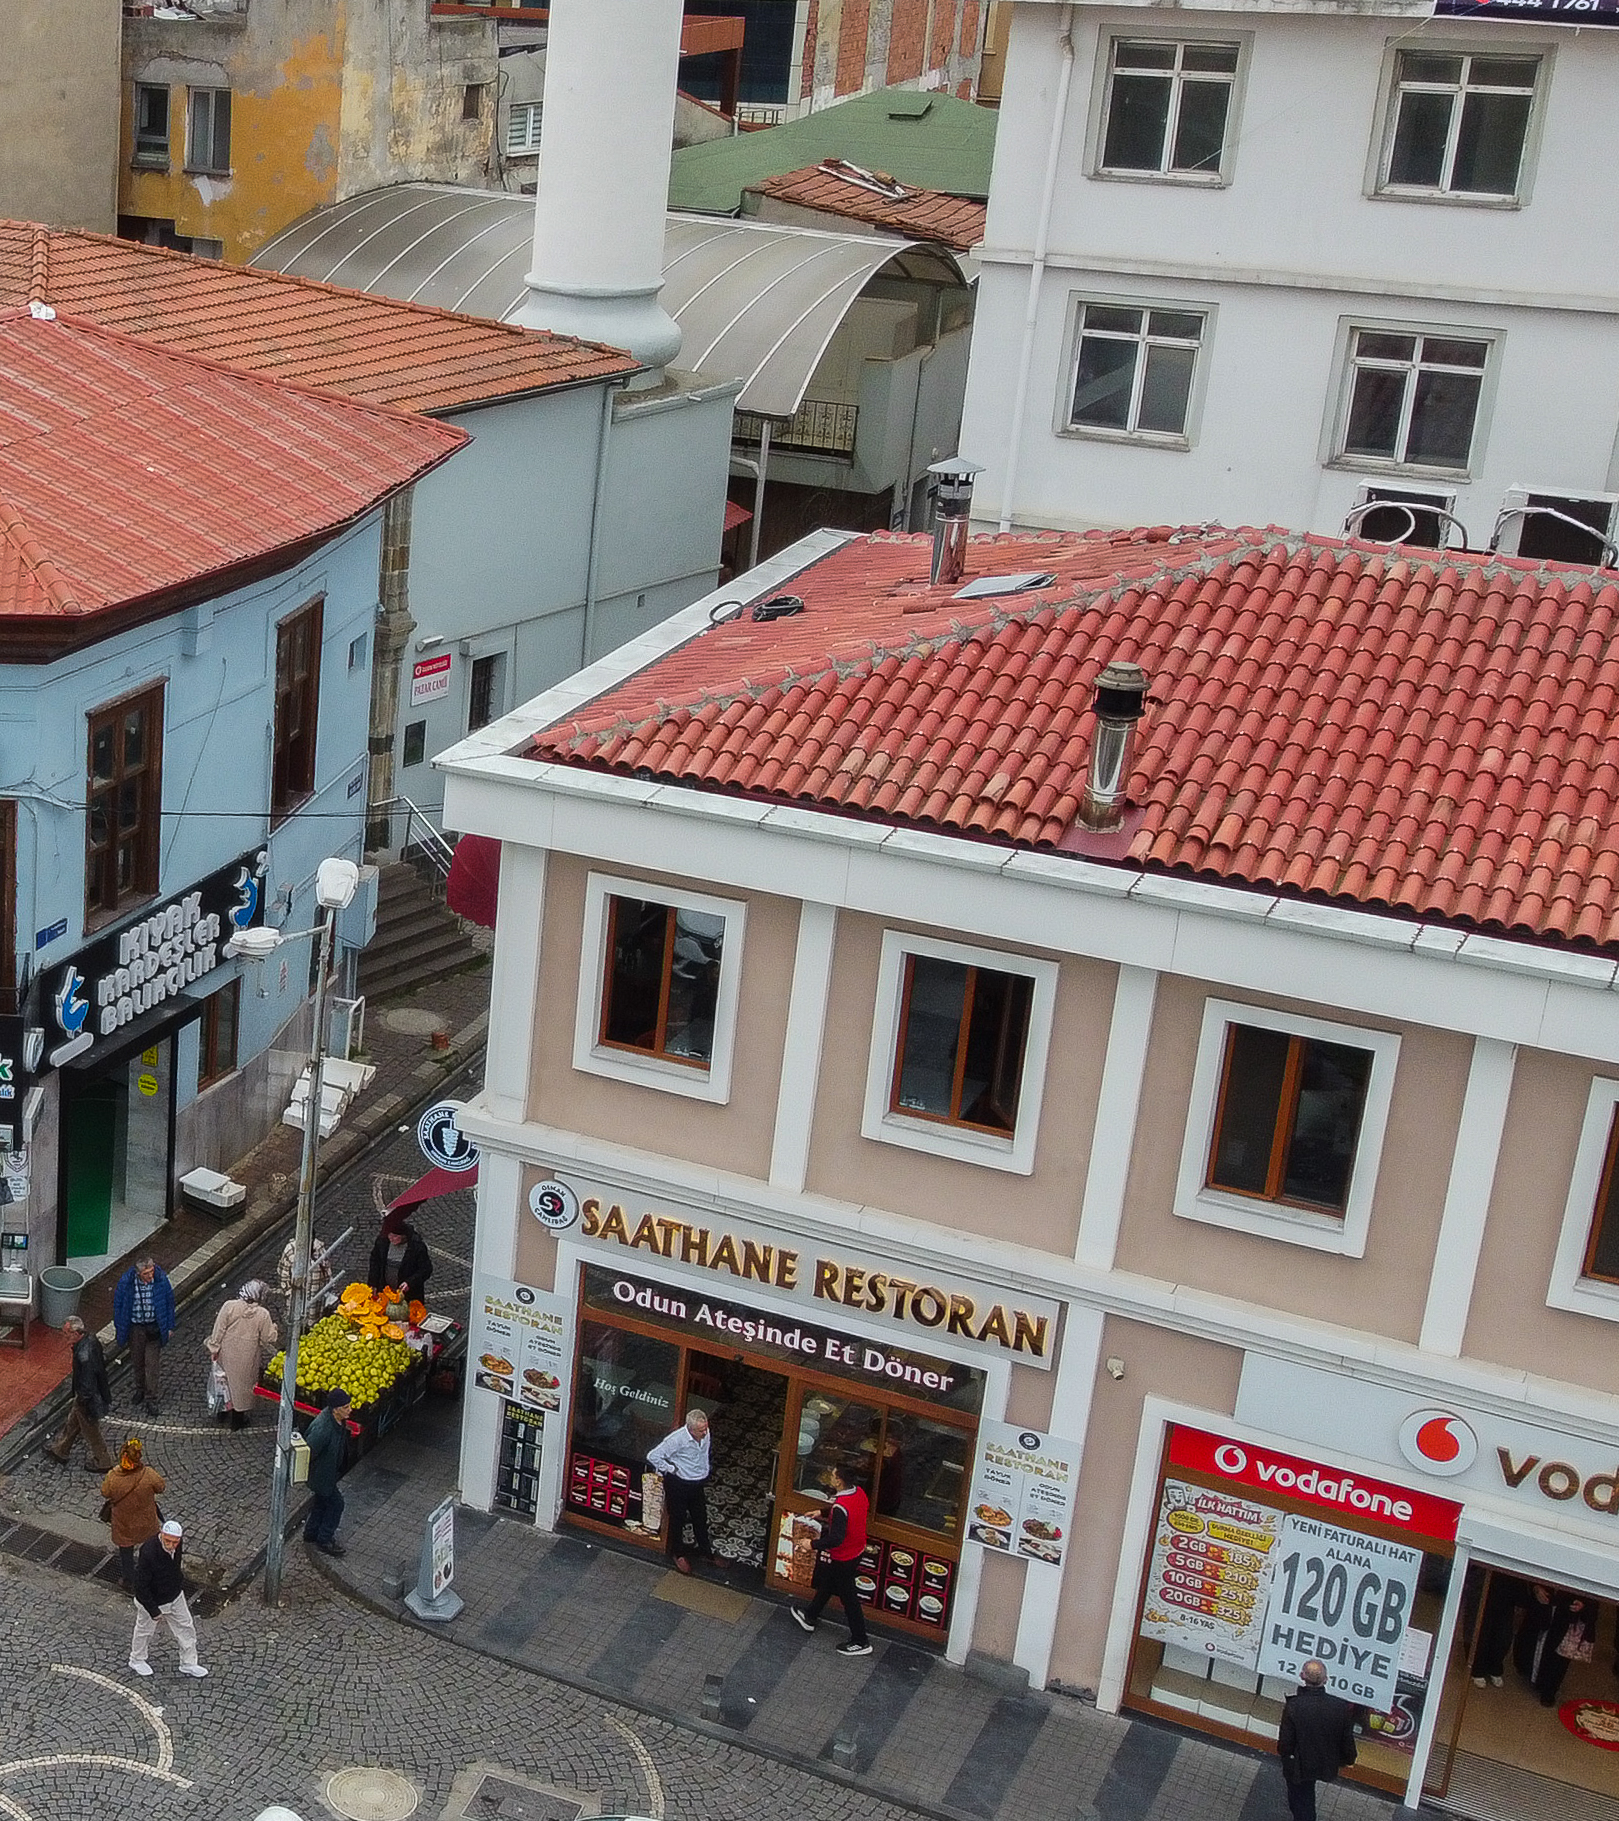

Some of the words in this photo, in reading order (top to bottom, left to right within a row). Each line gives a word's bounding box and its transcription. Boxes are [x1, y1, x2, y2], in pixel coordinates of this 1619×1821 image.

[119, 891, 203, 966] KIYAK
[100, 942, 217, 1036] BALIKÇILIK
[581, 1197, 799, 1291] SAATHANE
[812, 1258, 1050, 1358] RESTORAN
[484, 1295, 563, 1326] SAATHANE
[484, 1304, 563, 1336] RESTORAN
[613, 1281, 688, 1320] Odun
[694, 1303, 817, 1354] Ateşinde
[825, 1337, 856, 1366] Et
[863, 1348, 955, 1393] Döner
[593, 1377, 618, 1396] Hoş
[619, 1385, 670, 1408] Geldiniz
[984, 1452, 1069, 1484] RESTORAN
[985, 1441, 1069, 1473] SAATHANE
[1255, 1460, 1413, 1522] vodafone
[1197, 1496, 1216, 1511] İLK
[1216, 1501, 1259, 1522] HATTIM
[1178, 1537, 1188, 1548] 2
[1189, 1539, 1207, 1553] GB
[1291, 1518, 1323, 1538] YENİ
[1323, 1528, 1387, 1556] FATURALI
[1388, 1547, 1416, 1563] HAT
[1175, 1555, 1185, 1566] 5
[1186, 1557, 1204, 1571] GB
[1325, 1547, 1372, 1569] ALANA
[1168, 1571, 1185, 1584] 10
[1185, 1576, 1203, 1590] GB
[1165, 1588, 1183, 1602] 20
[1183, 1593, 1201, 1607] GB
[1282, 1551, 1348, 1628] 120
[1352, 1571, 1407, 1646] GB
[1271, 1623, 1392, 1680] HEDİYE
[1277, 1660, 1297, 1676] 12
[1329, 1674, 1349, 1691] 10
[1351, 1682, 1375, 1700] GB
